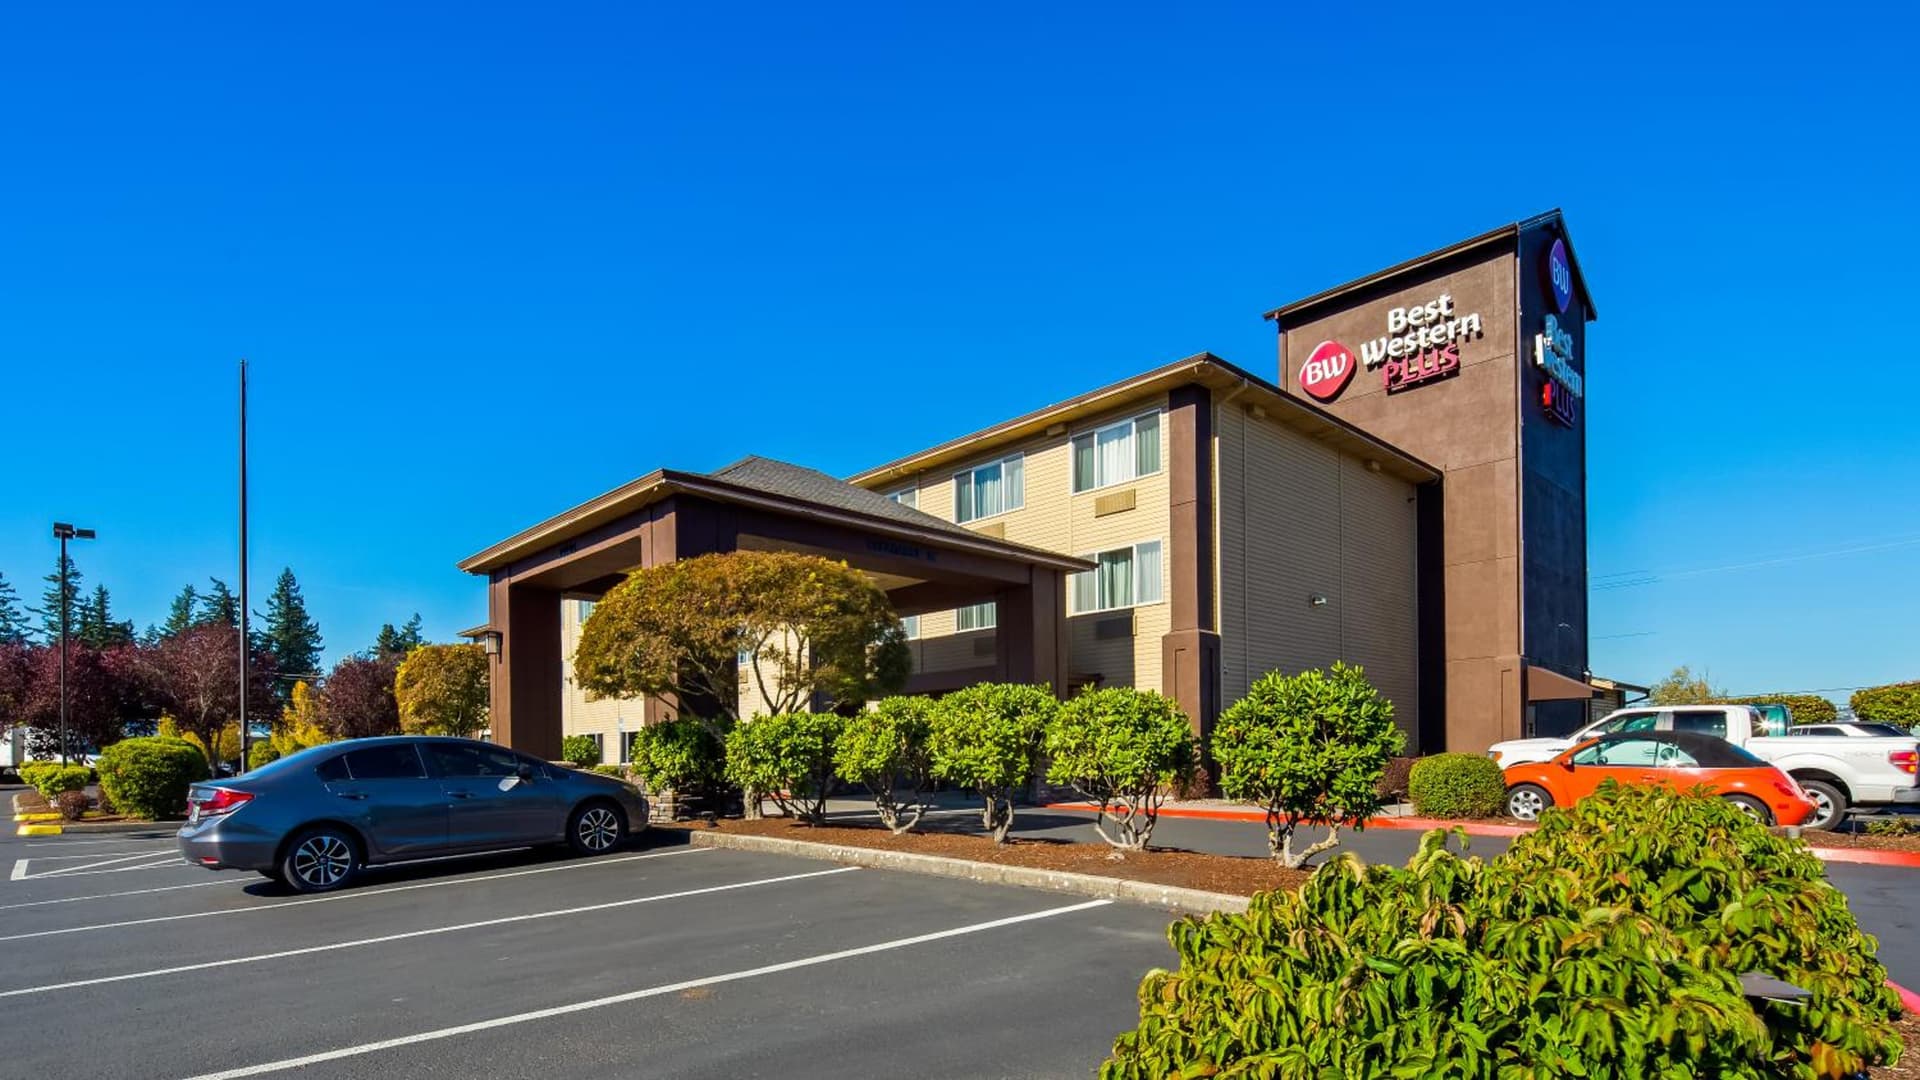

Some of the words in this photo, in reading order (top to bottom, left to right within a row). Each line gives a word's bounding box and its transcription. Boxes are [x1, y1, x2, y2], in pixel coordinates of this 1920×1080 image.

[1553, 257, 1569, 294] BW
[1388, 293, 1453, 333] Best
[1360, 312, 1481, 365] Western
[1306, 353, 1346, 385] BW
[1383, 343, 1459, 386] PLUS
[1543, 377, 1576, 423] PLUS
